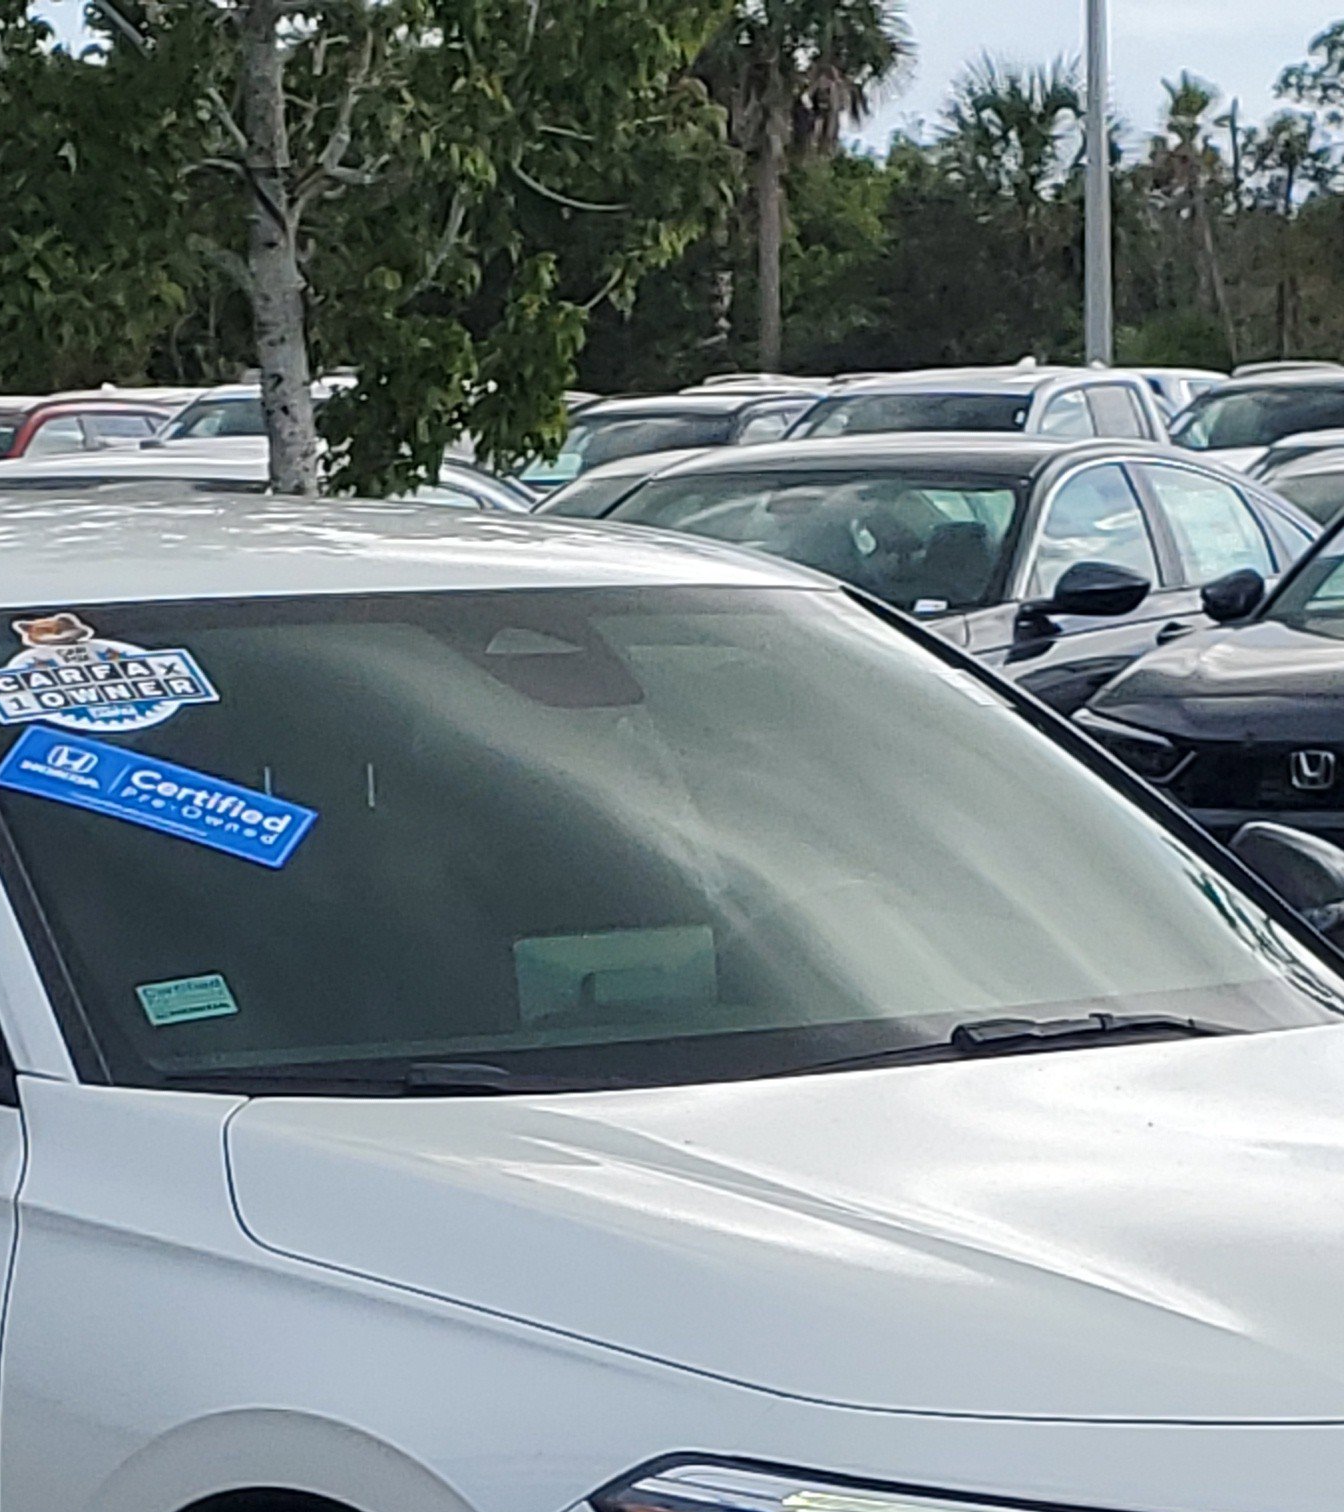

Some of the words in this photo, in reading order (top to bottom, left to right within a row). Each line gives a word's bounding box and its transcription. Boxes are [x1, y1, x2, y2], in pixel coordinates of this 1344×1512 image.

[8, 695, 31, 711] 1
[40, 678, 196, 708] OWNER
[121, 786, 279, 845] Pre-Owned
[131, 770, 292, 833] Certified
